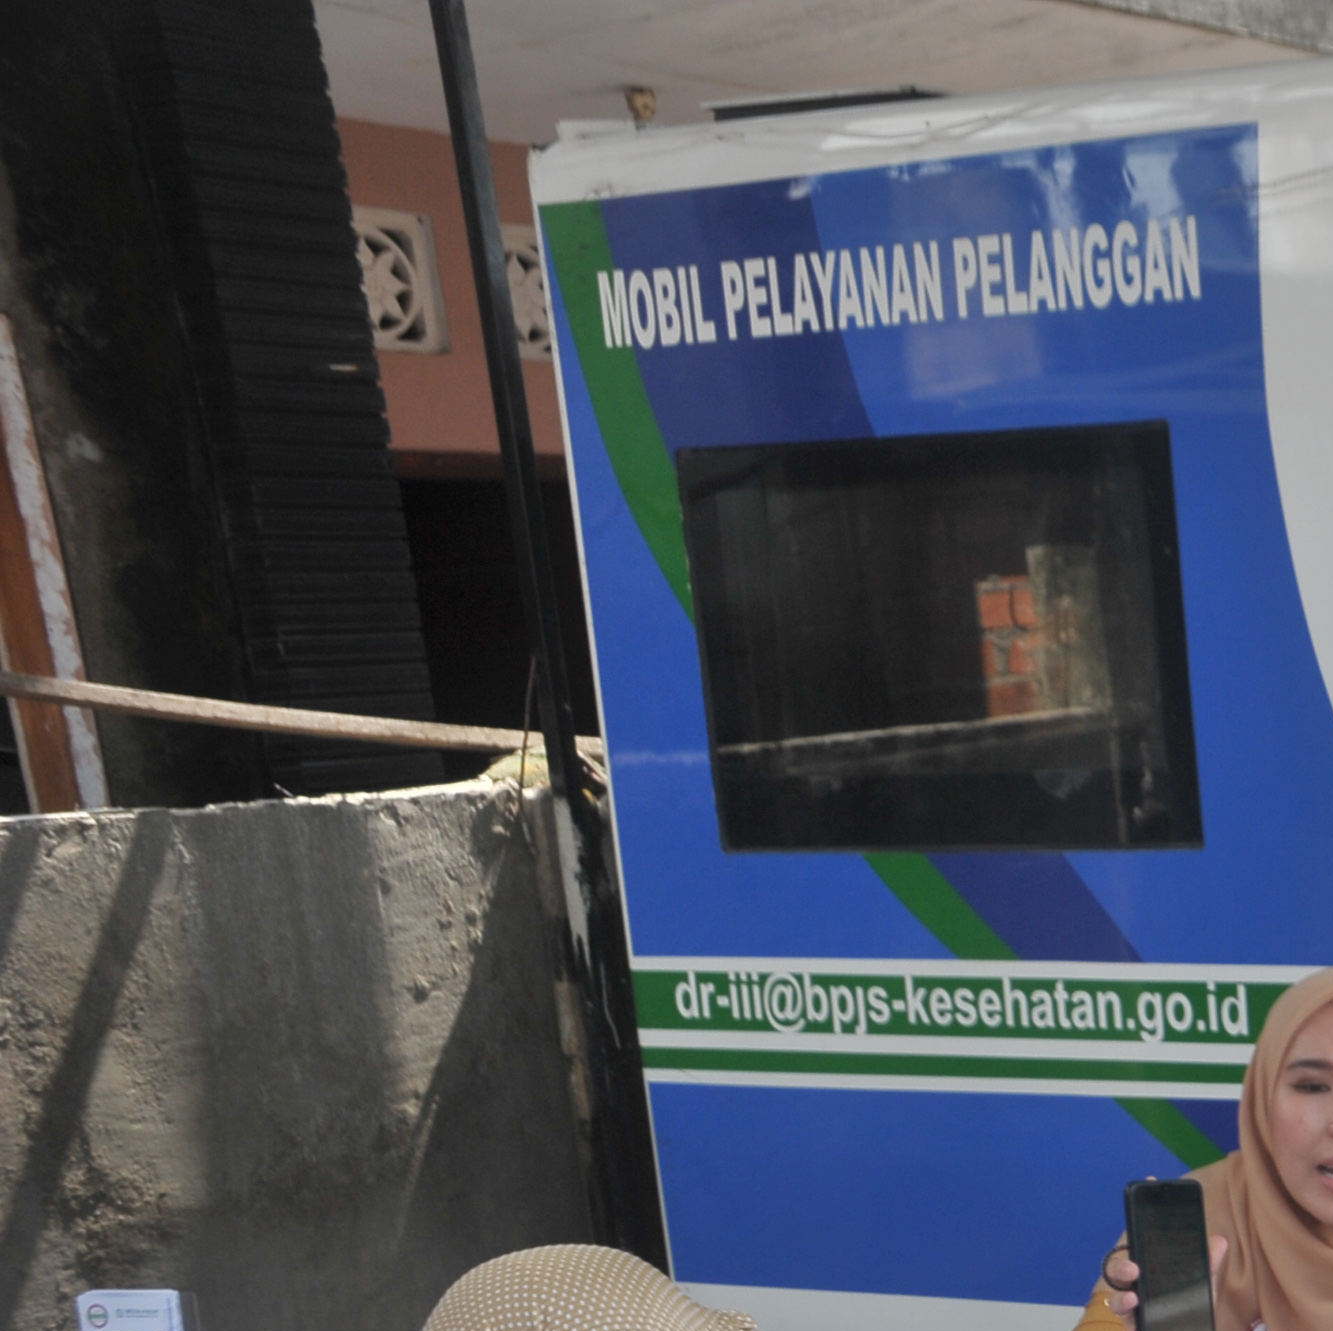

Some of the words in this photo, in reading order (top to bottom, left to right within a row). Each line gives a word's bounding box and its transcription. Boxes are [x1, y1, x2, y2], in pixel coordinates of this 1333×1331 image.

[597, 259, 716, 350] MOBIL
[720, 240, 943, 342] PELAYANAN
[954, 215, 1202, 320] PELANGGAN
[674, 970, 1250, 1042] dr-iii@bpjs-kesehatan.go.id
